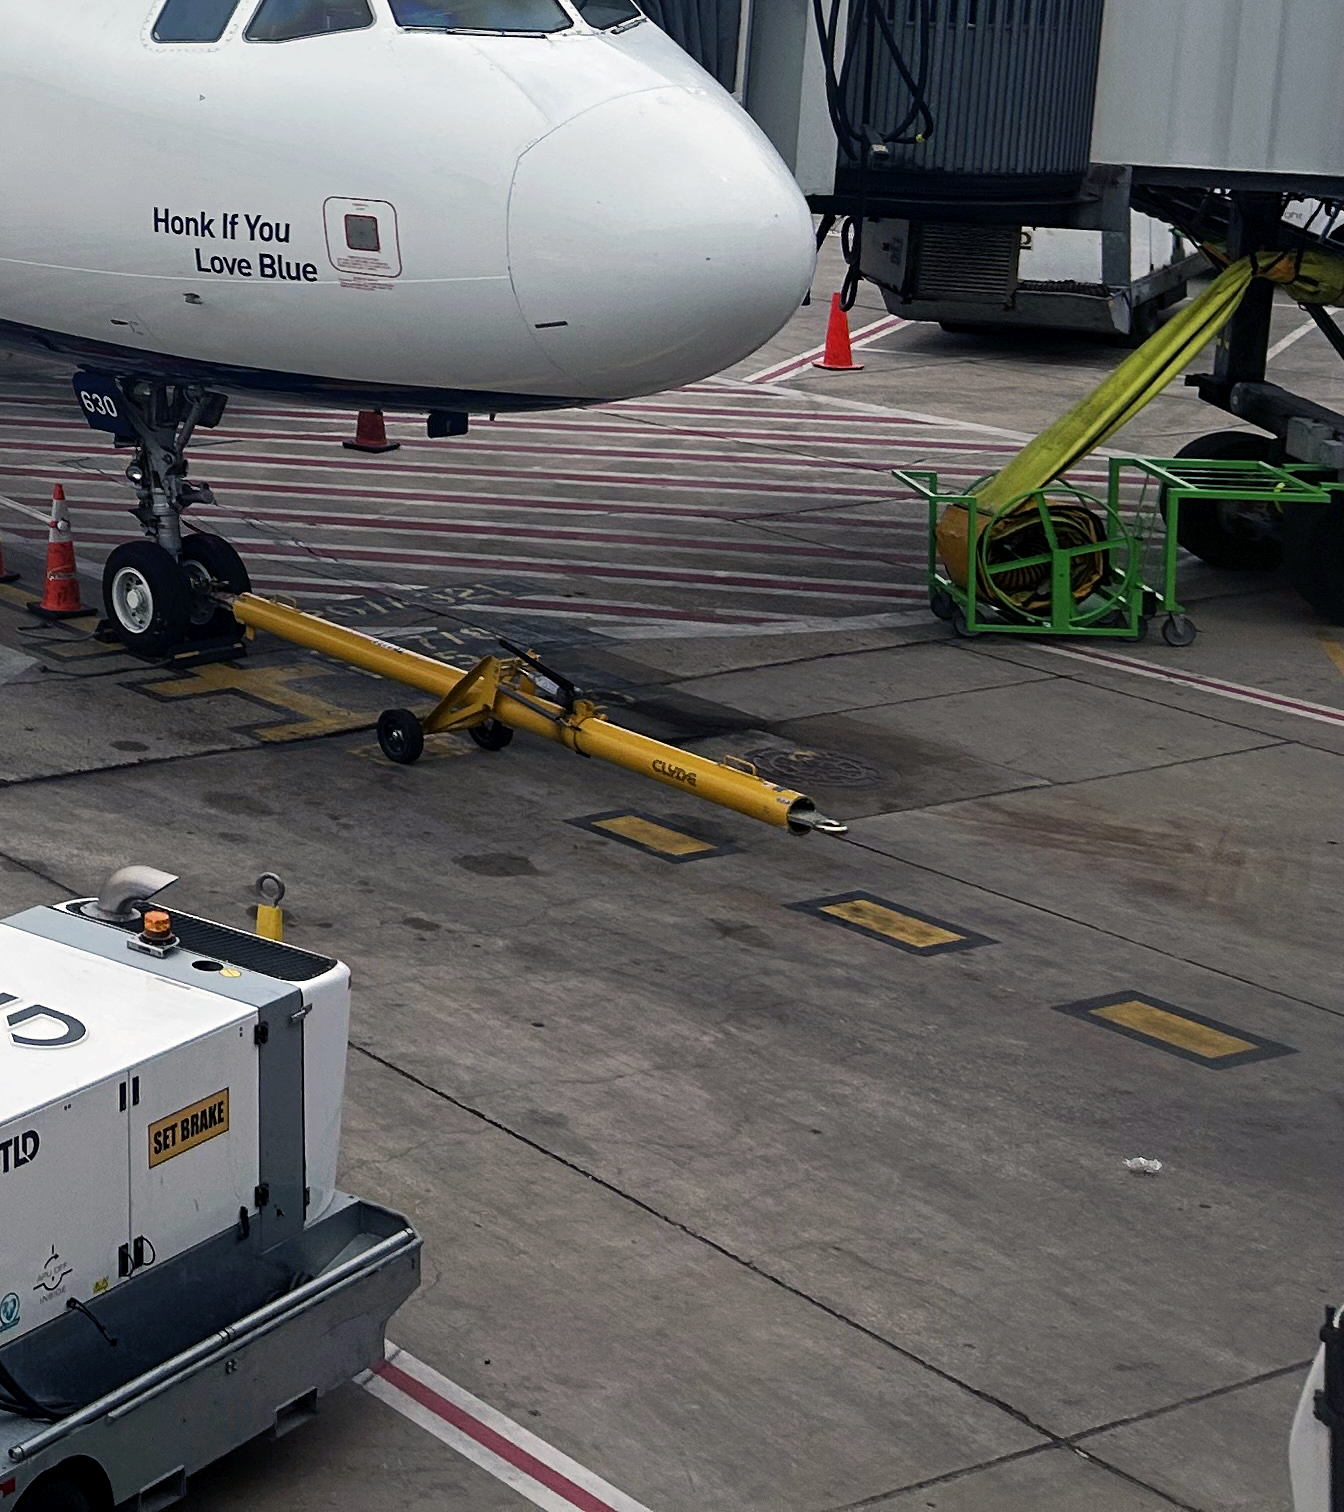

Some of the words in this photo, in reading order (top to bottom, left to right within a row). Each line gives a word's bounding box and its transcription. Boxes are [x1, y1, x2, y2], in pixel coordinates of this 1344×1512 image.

[153, 206, 216, 239] Honk
[222, 212, 239, 240] If
[244, 213, 291, 244] You
[194, 247, 252, 277] Love
[258, 252, 318, 282] Blue
[80, 390, 118, 418] 630
[153, 1122, 179, 1156] SET
[180, 1100, 225, 1142] BRAKE
